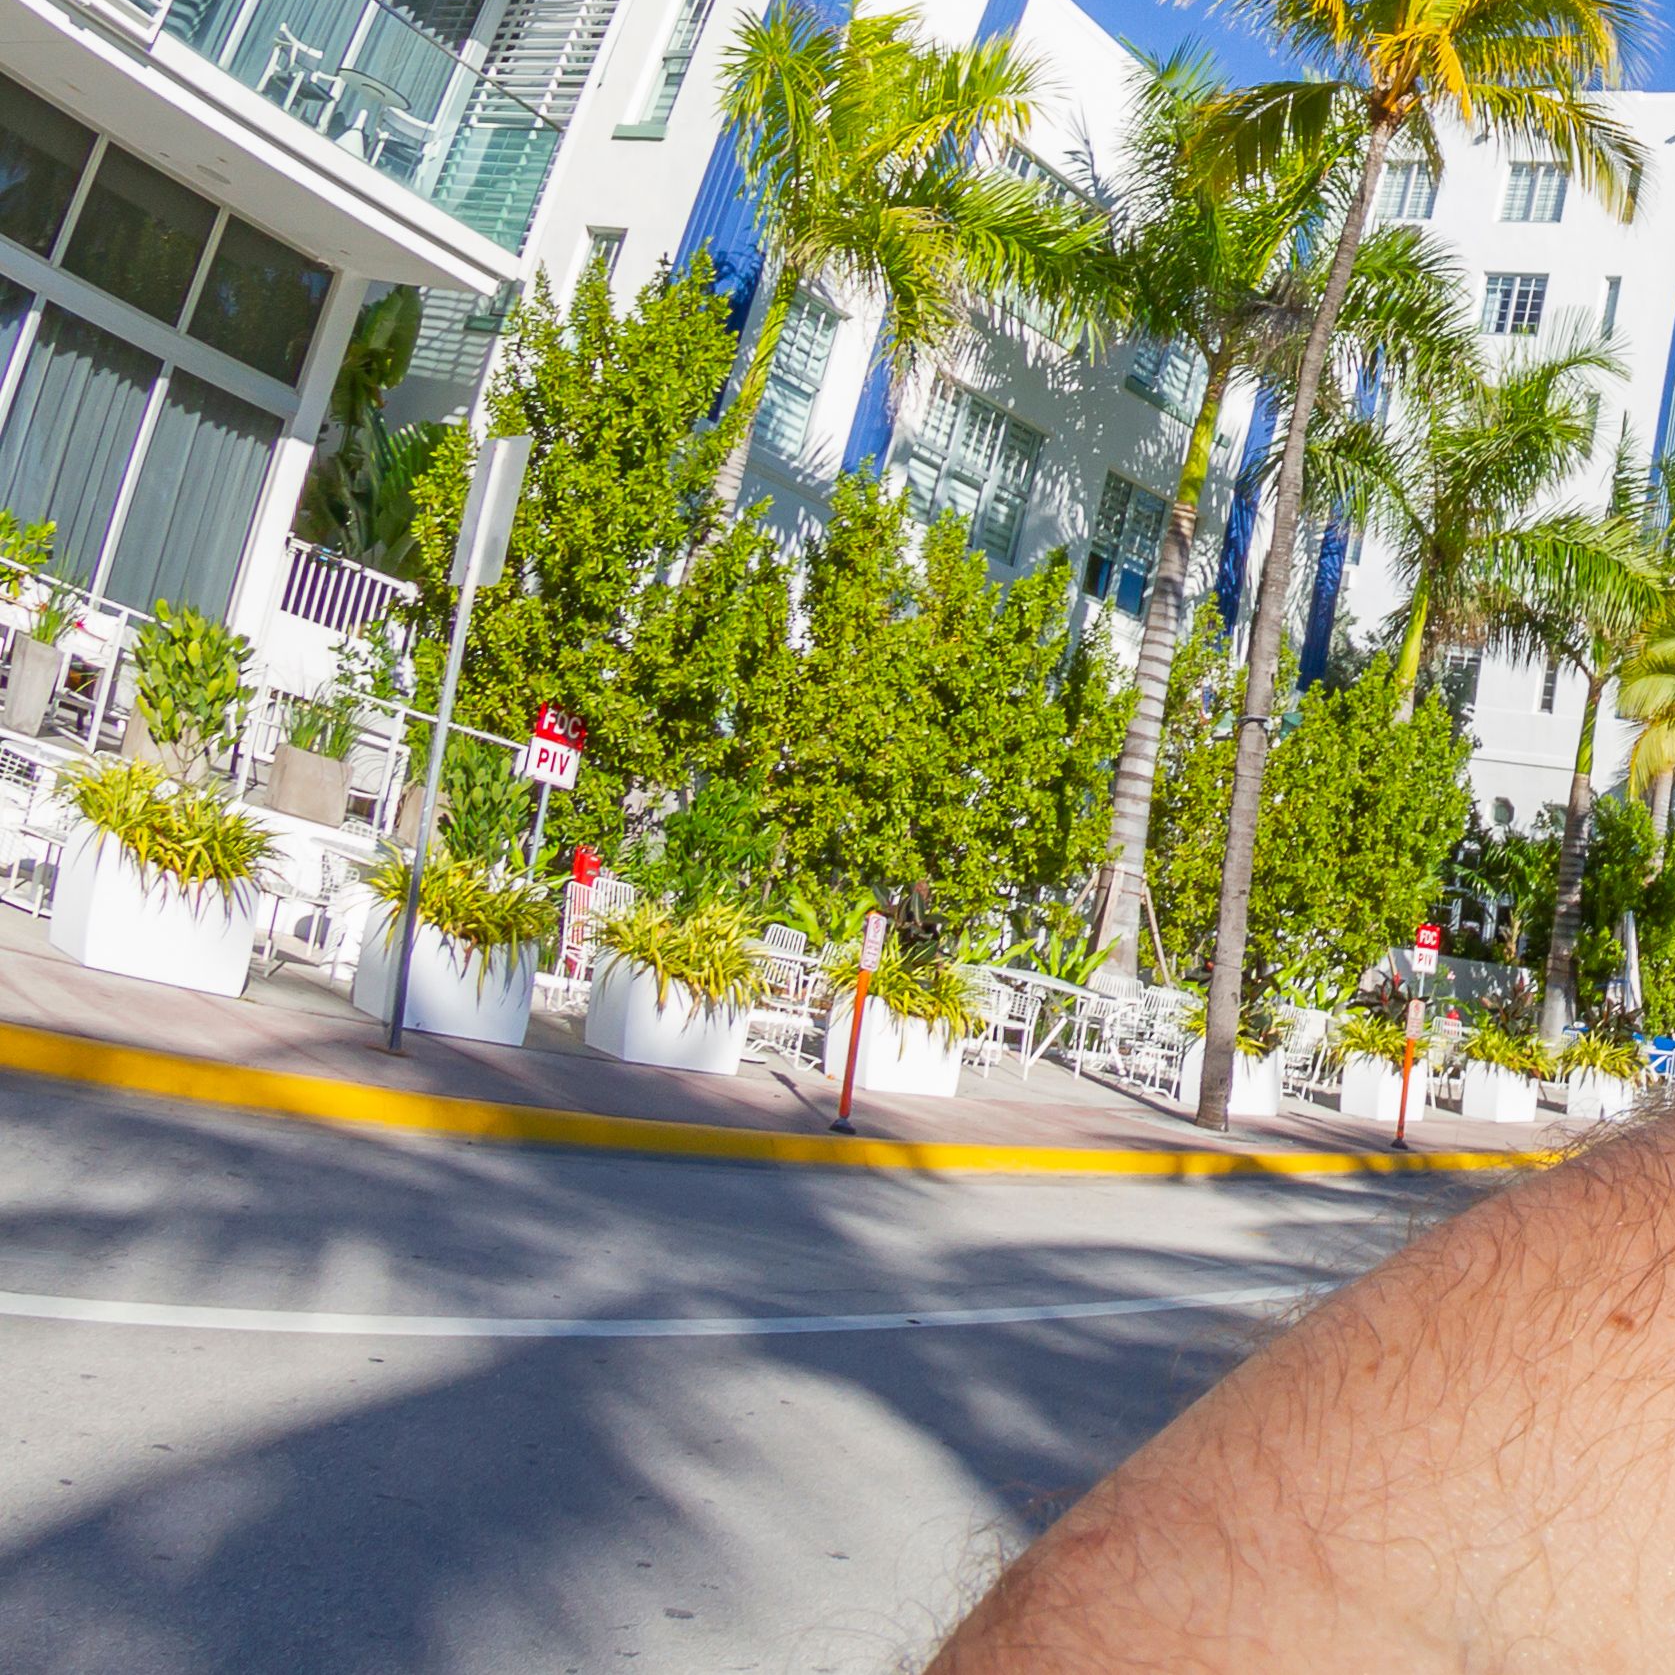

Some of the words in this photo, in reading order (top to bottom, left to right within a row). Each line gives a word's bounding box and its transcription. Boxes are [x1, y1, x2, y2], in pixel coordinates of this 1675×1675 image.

[542, 708, 582, 739] FDC
[536, 747, 570, 775] PIV
[1419, 929, 1438, 945] FDC
[1418, 953, 1433, 966] PIV
